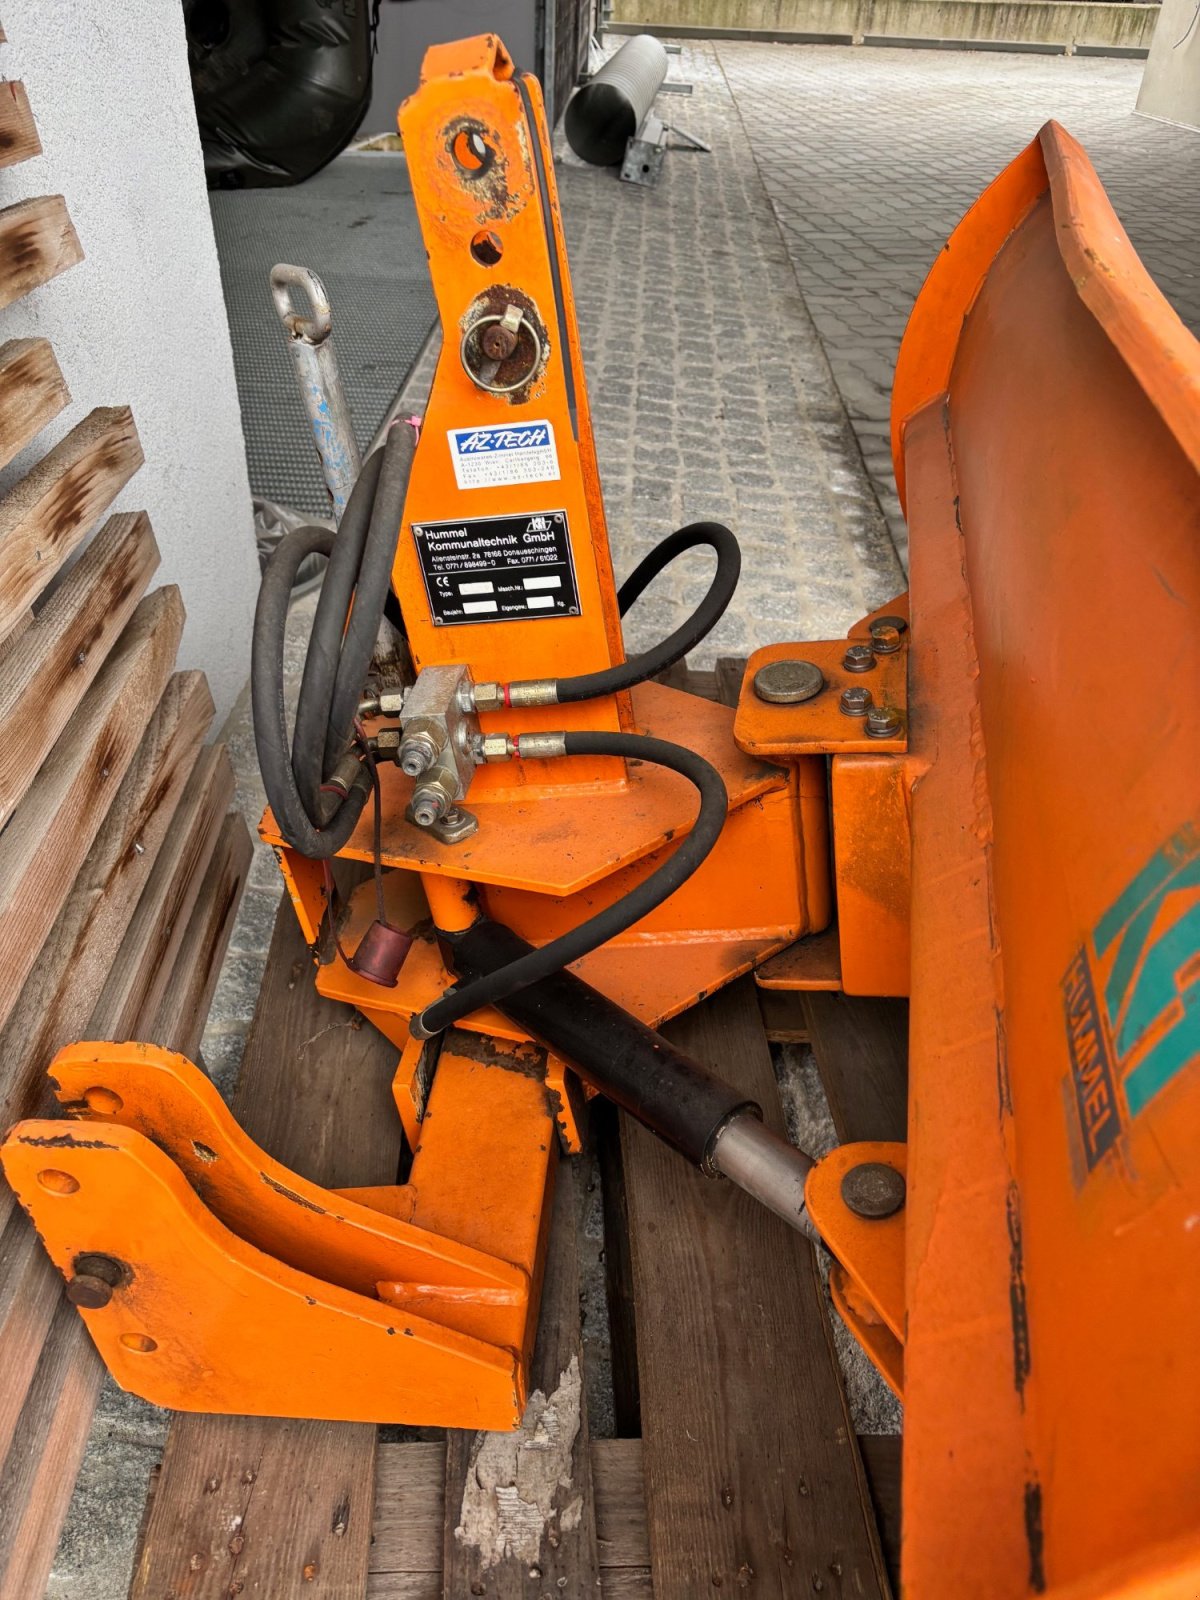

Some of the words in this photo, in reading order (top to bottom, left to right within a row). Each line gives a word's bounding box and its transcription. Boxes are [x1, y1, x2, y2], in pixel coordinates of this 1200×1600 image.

[425, 527, 468, 540] Hummel
[427, 534, 518, 552] Kommunaltechnik
[522, 530, 555, 544] GmbH
[1065, 957, 1112, 1154] HUMMEL
